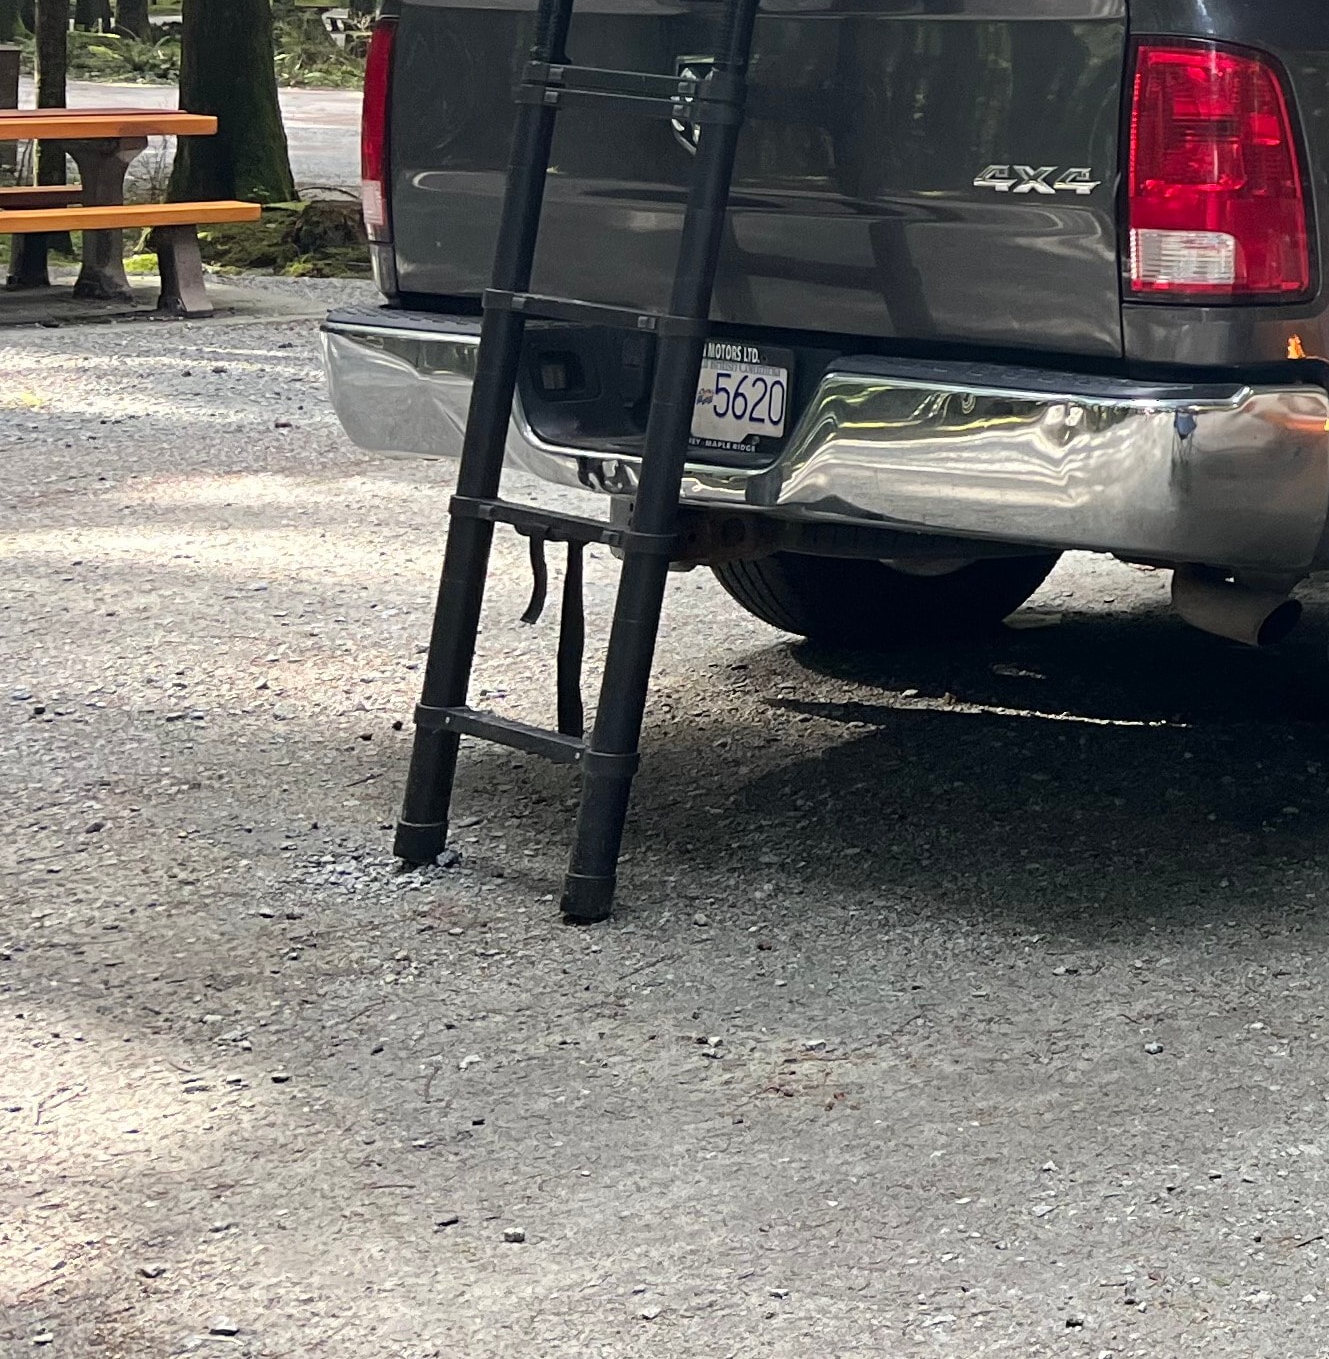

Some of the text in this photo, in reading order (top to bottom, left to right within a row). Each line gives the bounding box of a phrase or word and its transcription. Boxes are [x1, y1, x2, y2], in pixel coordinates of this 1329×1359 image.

[973, 164, 1102, 195] 4X4
[708, 342, 742, 362] MOTORS
[743, 346, 761, 364] LTD.
[713, 372, 785, 426] 5620
[705, 439, 731, 450] MAPLE
[732, 443, 756, 453] RIDGE
